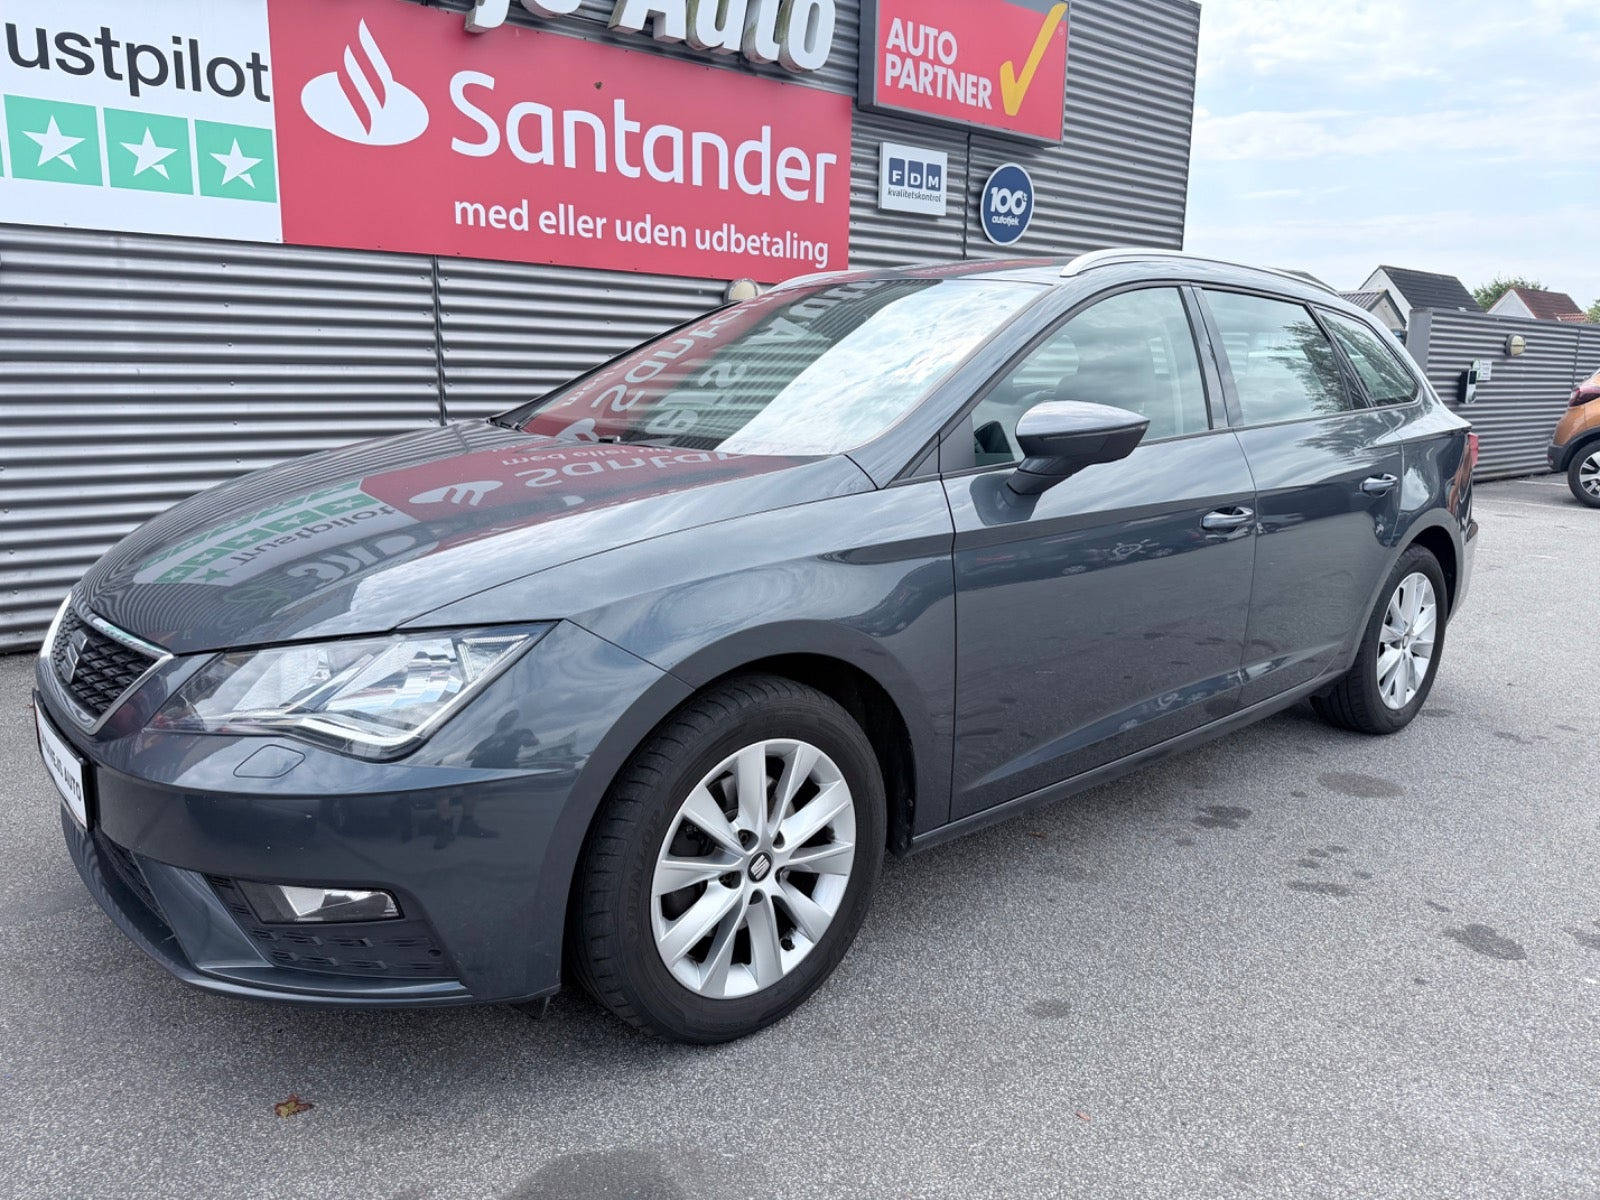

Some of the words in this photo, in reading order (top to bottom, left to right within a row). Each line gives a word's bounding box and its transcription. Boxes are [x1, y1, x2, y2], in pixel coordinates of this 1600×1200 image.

[5, 22, 271, 102] ustpilot
[886, 17, 958, 65] AUTO
[884, 53, 993, 110] PARTNER
[449, 70, 837, 204] Santander
[888, 187, 942, 203] kvalitetskontrol
[454, 199, 529, 232] med
[538, 203, 607, 239] eller
[615, 213, 687, 248] uden
[695, 223, 829, 268] udbetaling
